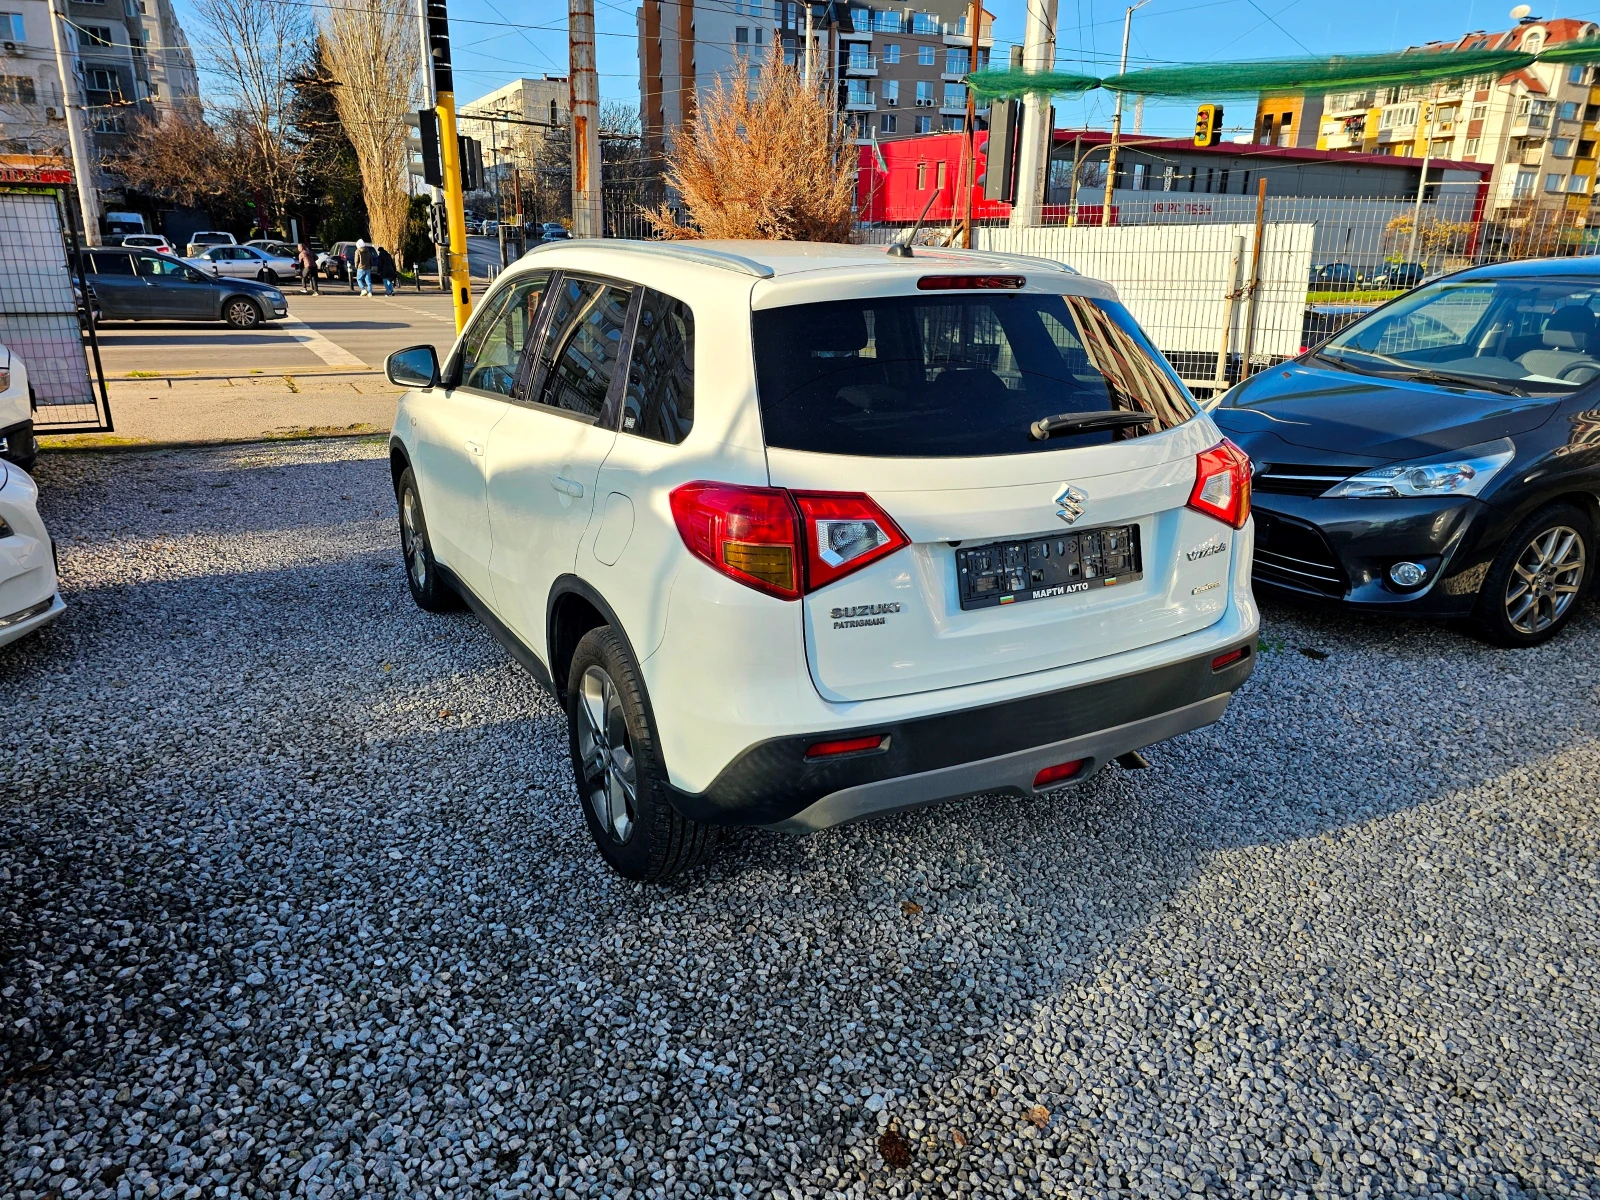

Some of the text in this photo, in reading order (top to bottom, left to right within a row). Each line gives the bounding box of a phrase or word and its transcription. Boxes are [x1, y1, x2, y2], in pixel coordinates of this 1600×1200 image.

[1032, 582, 1089, 599] МАРТИ АУТО
[830, 601, 901, 619] SUZUKI
[833, 617, 886, 630] PATRIGNANI
